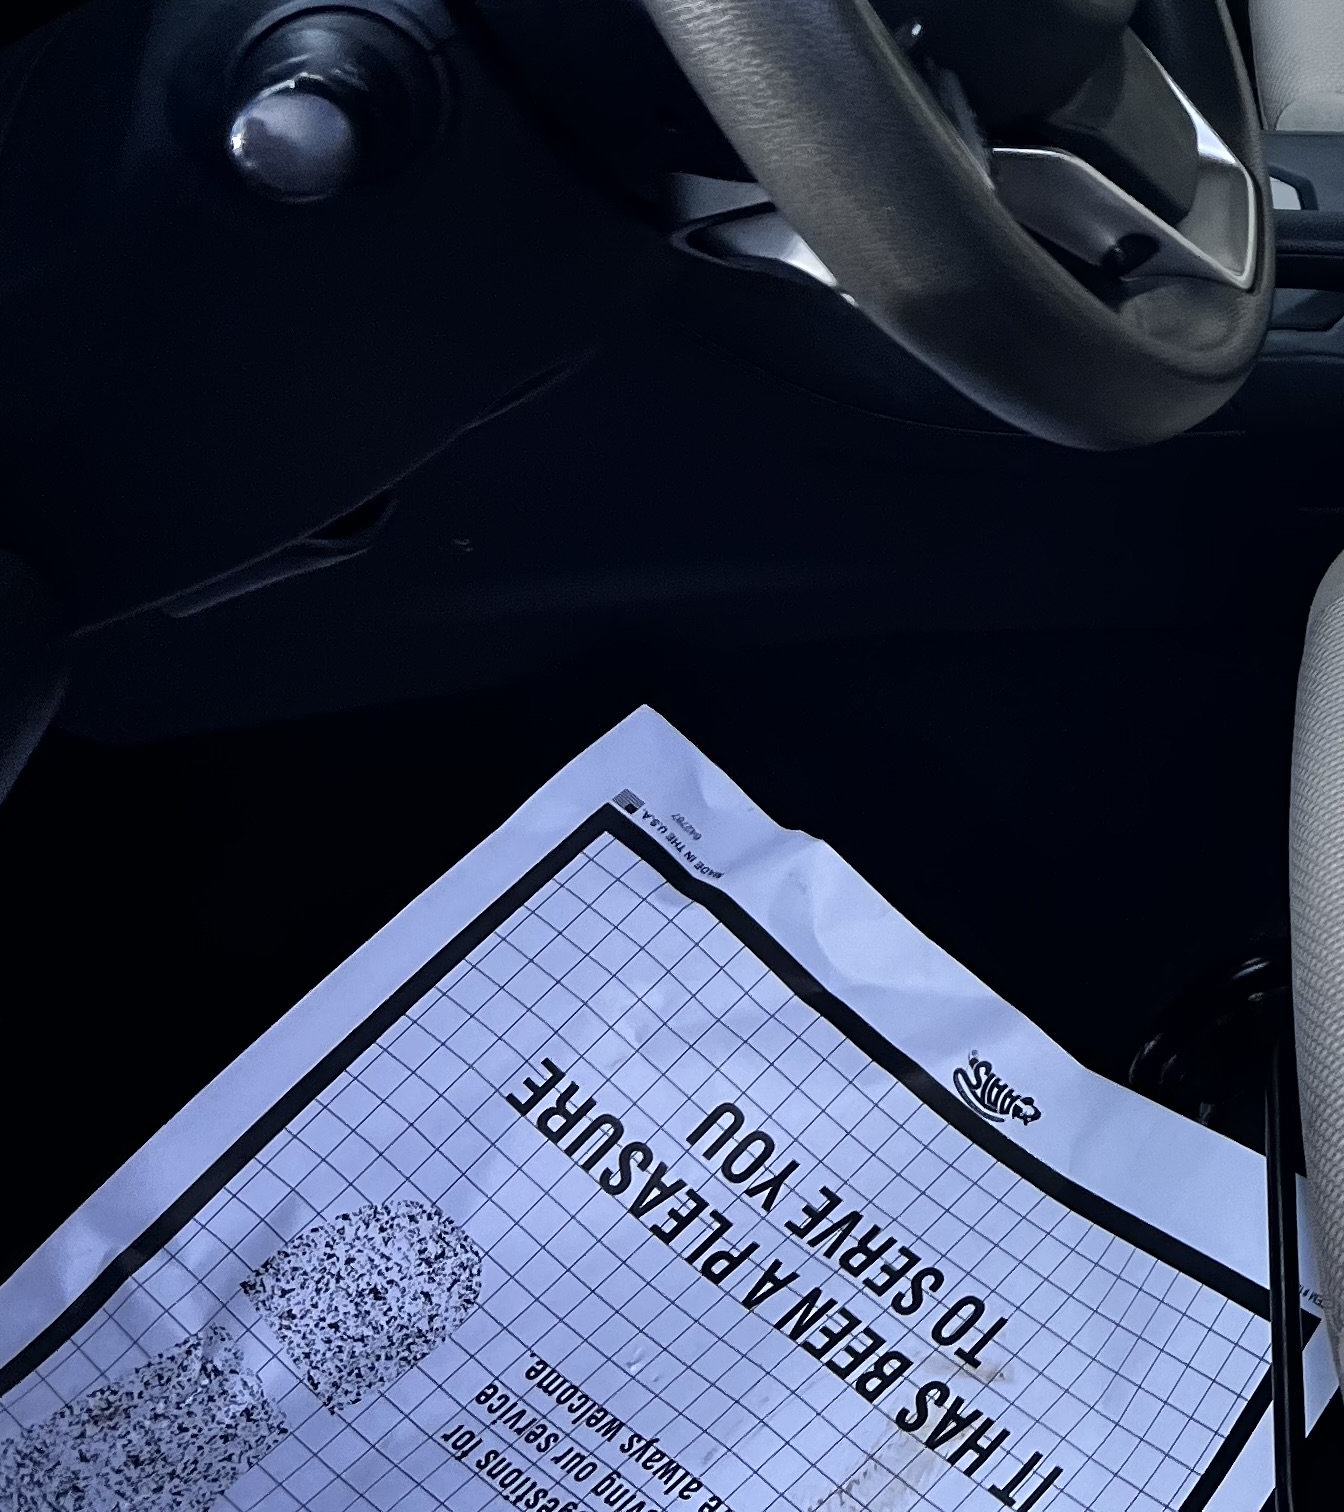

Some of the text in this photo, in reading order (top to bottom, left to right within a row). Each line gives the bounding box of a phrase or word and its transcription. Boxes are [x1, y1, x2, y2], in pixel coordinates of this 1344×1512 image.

[665, 832, 686, 852] THE
[683, 850, 697, 863] IN
[686, 1101, 1009, 1369] TO SERVE YOU
[504, 1056, 1064, 1512] IT HAS BEEN A PLEASURE
[440, 1424, 483, 1461] for
[475, 1382, 560, 1453] service
[524, 1349, 704, 1500] always welcome.
[551, 1446, 598, 1482] our
